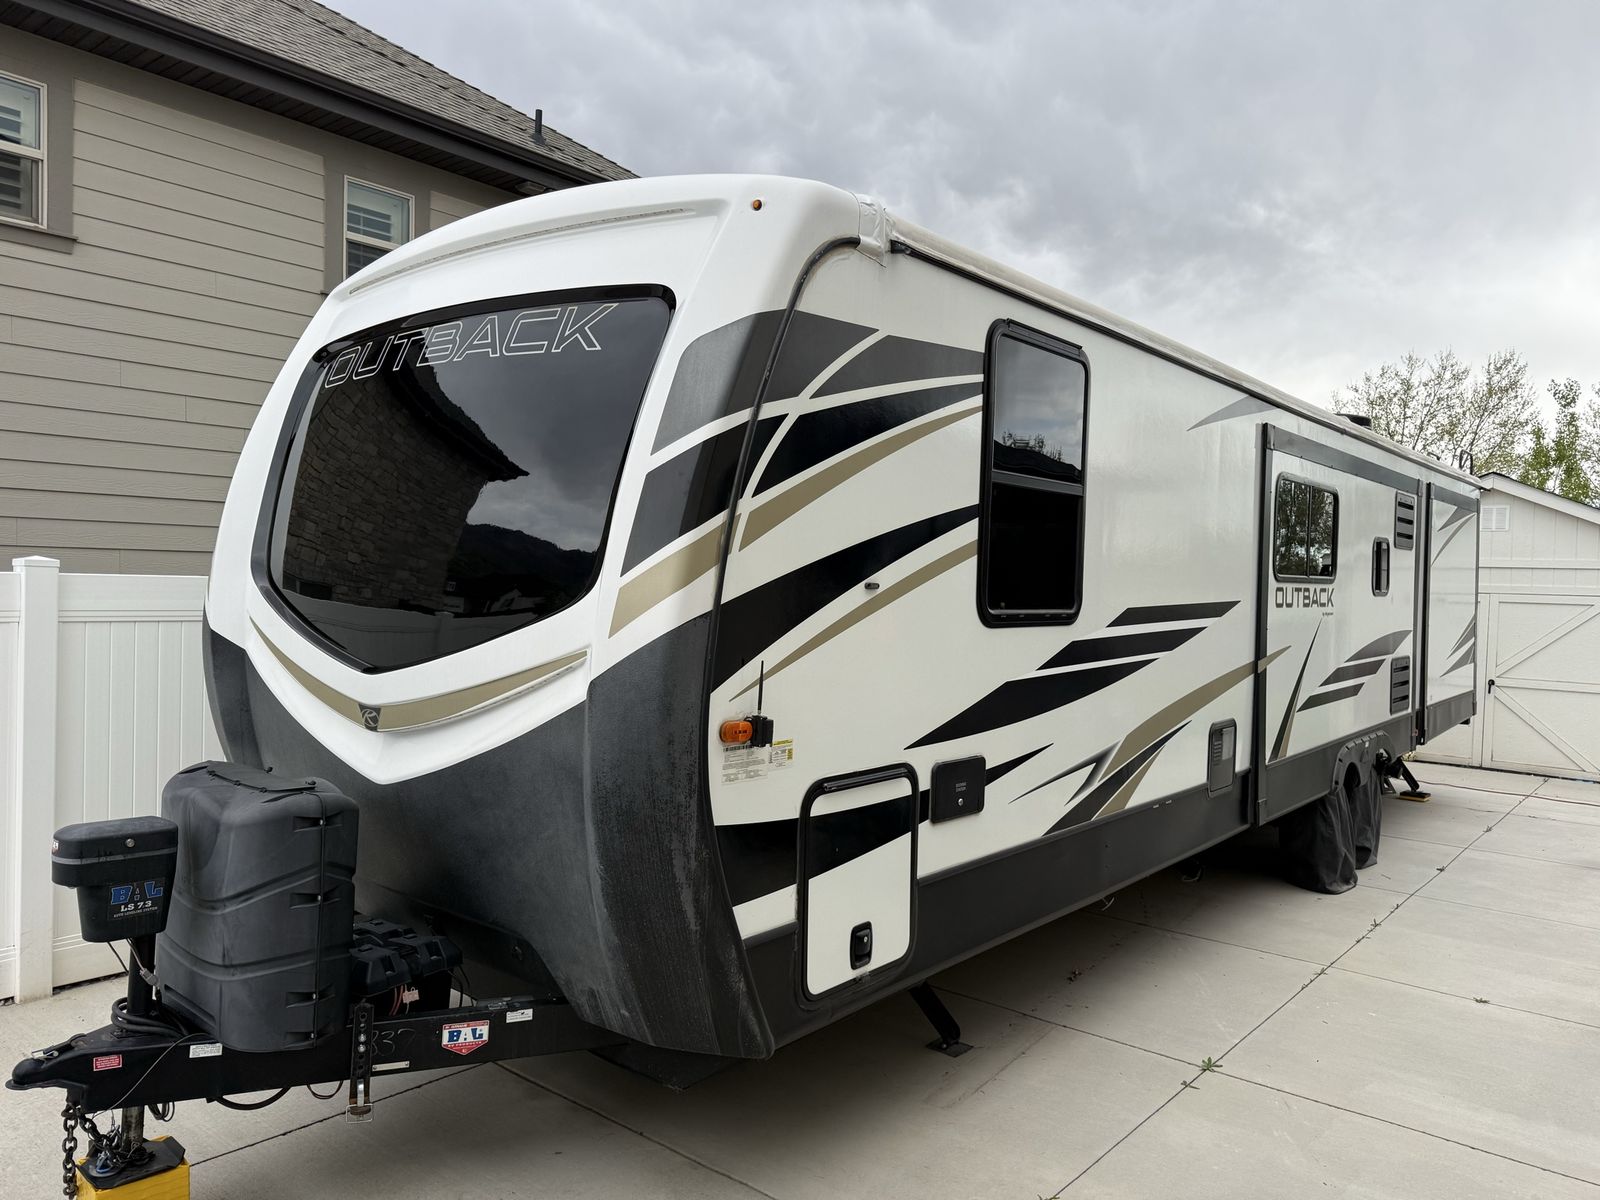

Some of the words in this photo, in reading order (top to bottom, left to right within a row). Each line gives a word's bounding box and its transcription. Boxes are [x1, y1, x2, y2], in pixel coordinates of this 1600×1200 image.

[325, 303, 619, 388] OUTBACK
[1275, 586, 1335, 608] OUTBACK
[120, 903, 135, 912] LS
[447, 1027, 484, 1043] BAL
